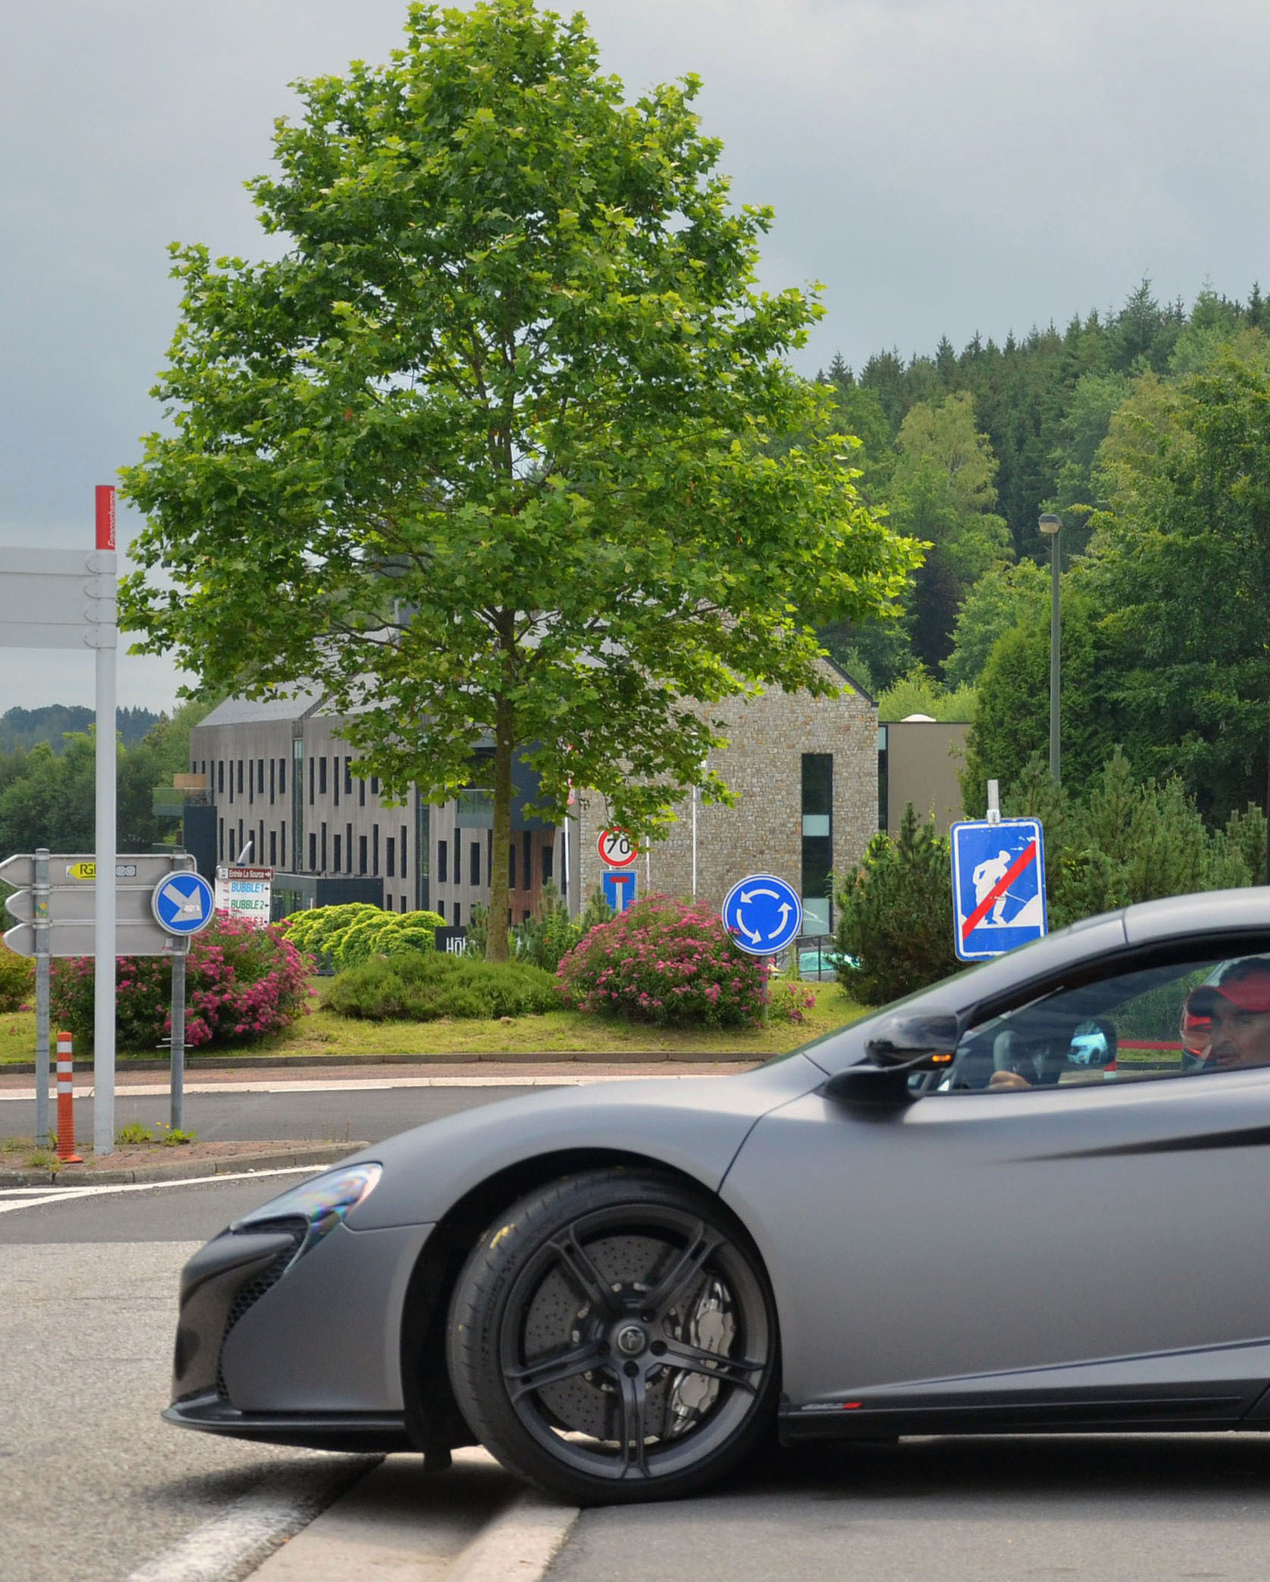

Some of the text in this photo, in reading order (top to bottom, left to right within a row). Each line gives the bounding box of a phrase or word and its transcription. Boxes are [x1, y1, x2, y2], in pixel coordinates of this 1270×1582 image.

[606, 838, 630, 855] 70
[231, 882, 265, 893] BUBBLE 1
[231, 899, 265, 910] BUBBLE 2
